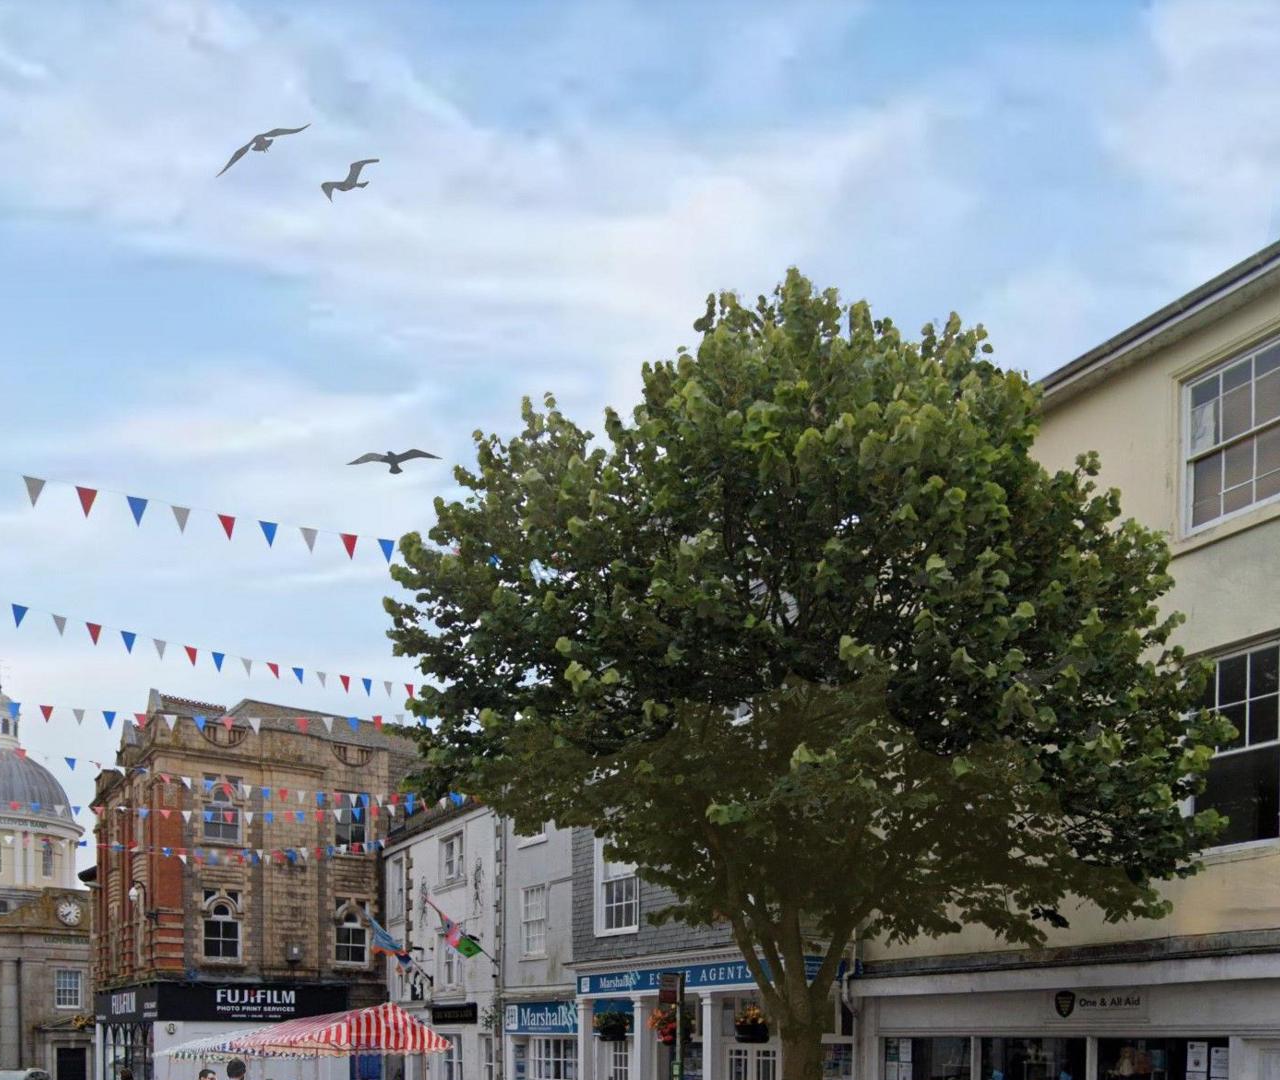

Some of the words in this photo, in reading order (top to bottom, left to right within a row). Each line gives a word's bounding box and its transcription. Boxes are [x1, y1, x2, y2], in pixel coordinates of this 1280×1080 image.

[700, 965, 753, 982] AGENTS
[216, 989, 296, 1004] FUJIFILM
[1079, 998, 1097, 1007] One
[1099, 998, 1107, 1006] &
[1110, 997, 1122, 1006] All
[1124, 996, 1140, 1006] Aid
